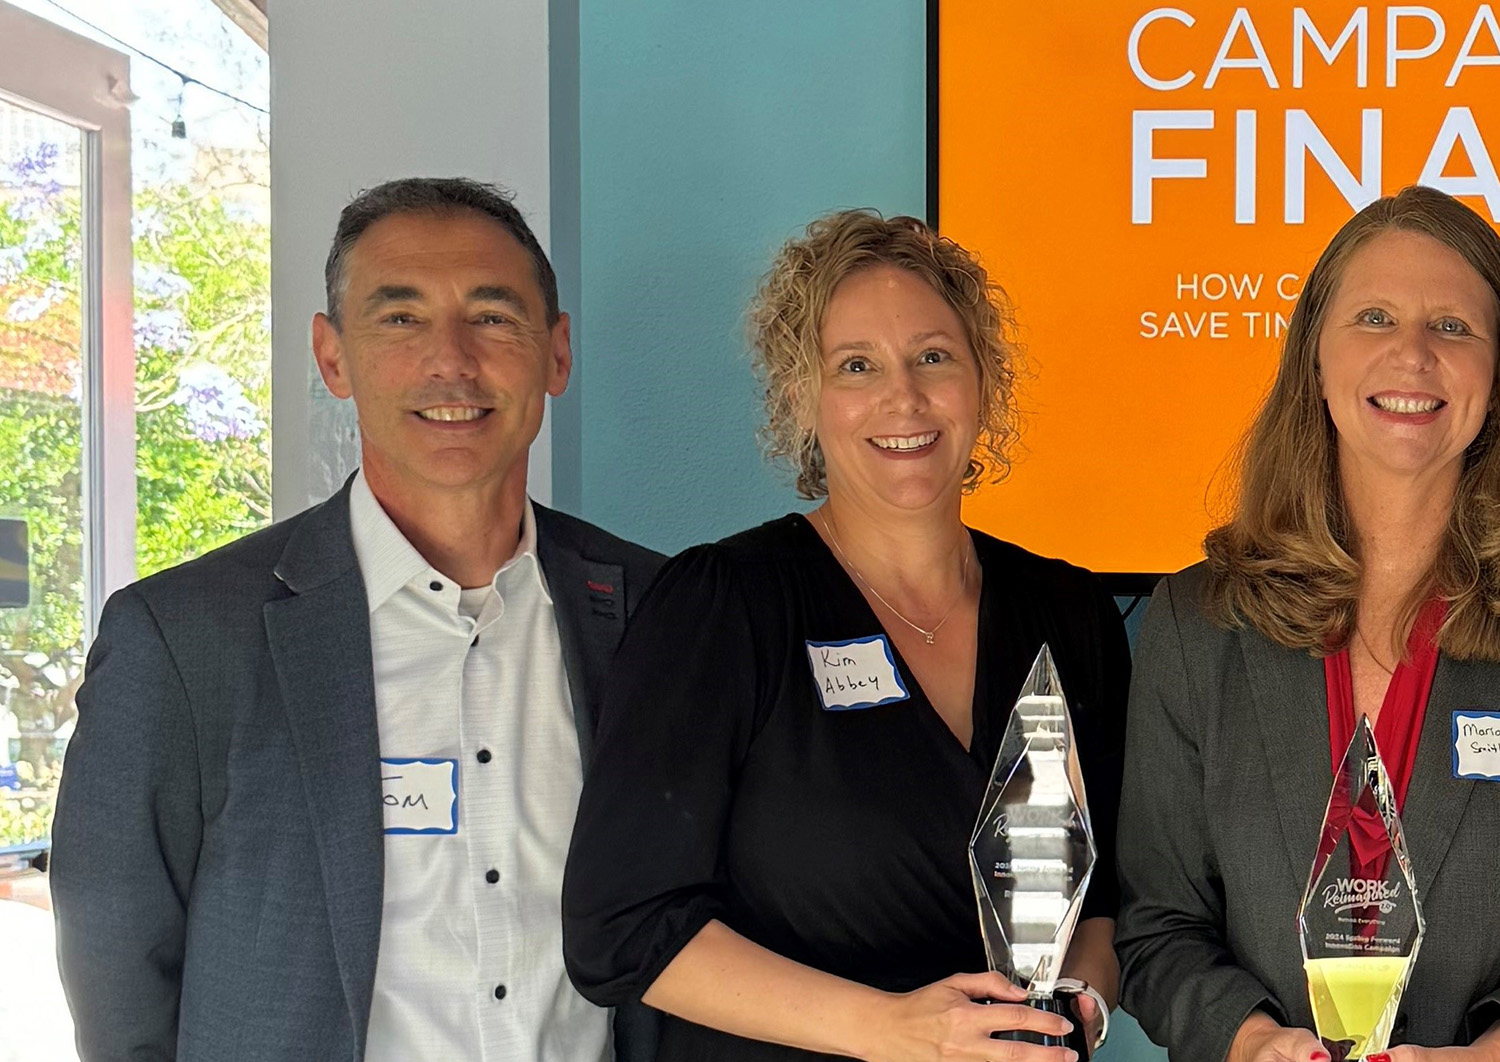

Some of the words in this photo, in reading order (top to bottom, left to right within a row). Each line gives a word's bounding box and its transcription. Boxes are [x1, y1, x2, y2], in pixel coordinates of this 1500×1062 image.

[1176, 273, 1264, 301] HOW
[1140, 311, 1229, 338] SAVE
[821, 649, 857, 668] Kim
[825, 675, 880, 694] Abbey
[1337, 878, 1389, 893] WORK
